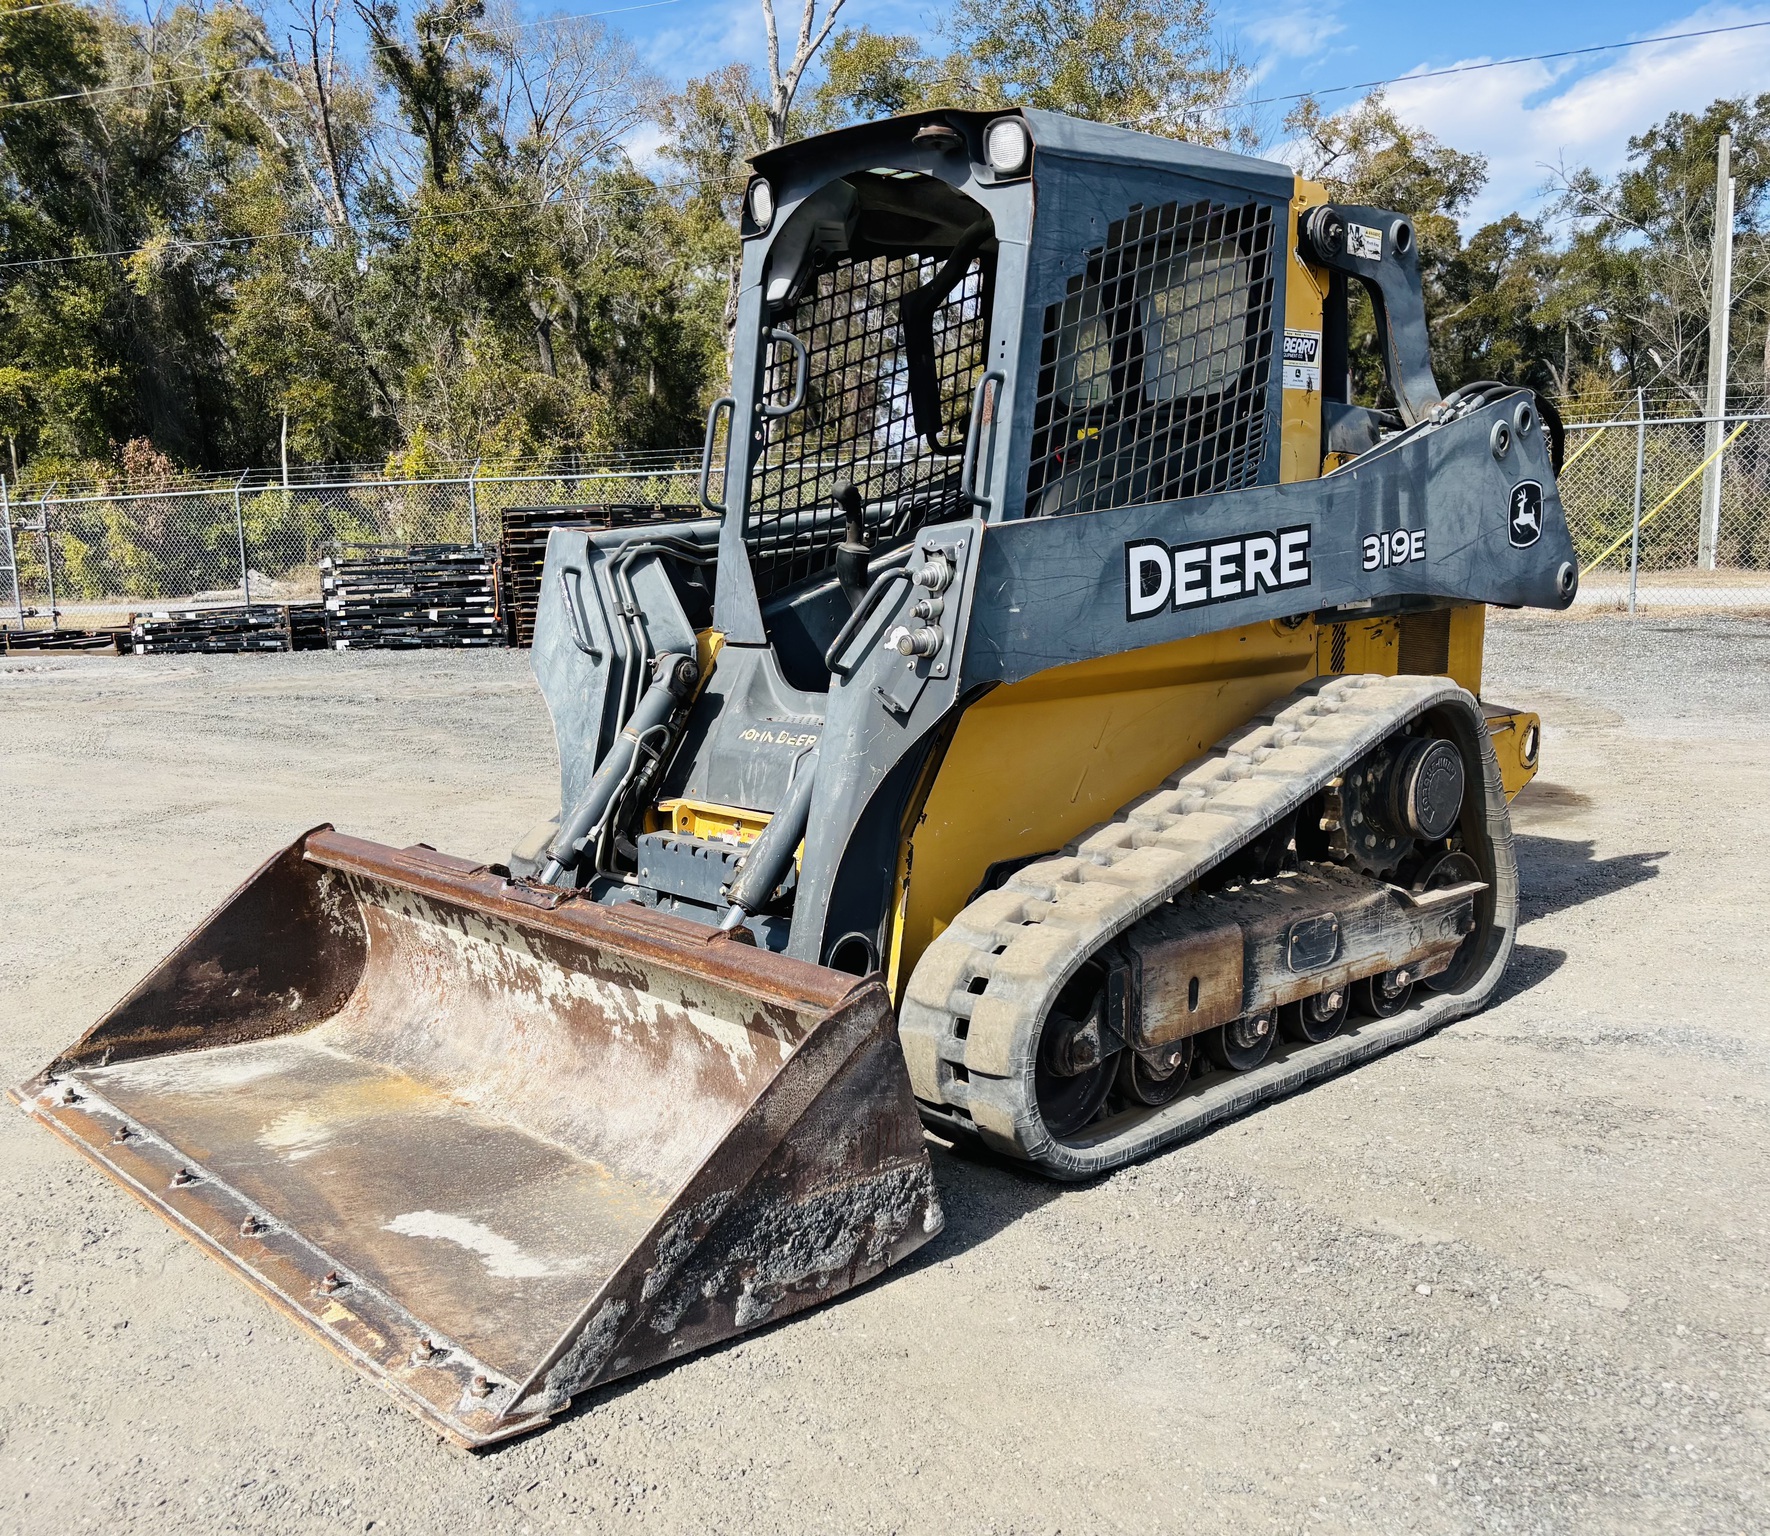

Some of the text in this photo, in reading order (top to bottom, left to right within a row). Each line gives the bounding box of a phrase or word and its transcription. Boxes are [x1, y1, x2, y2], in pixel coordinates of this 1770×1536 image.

[1284, 337, 1315, 361] BEARD
[1362, 529, 1426, 571] 319E
[1128, 529, 1309, 615] DEERE
[775, 730, 818, 747] DEER
